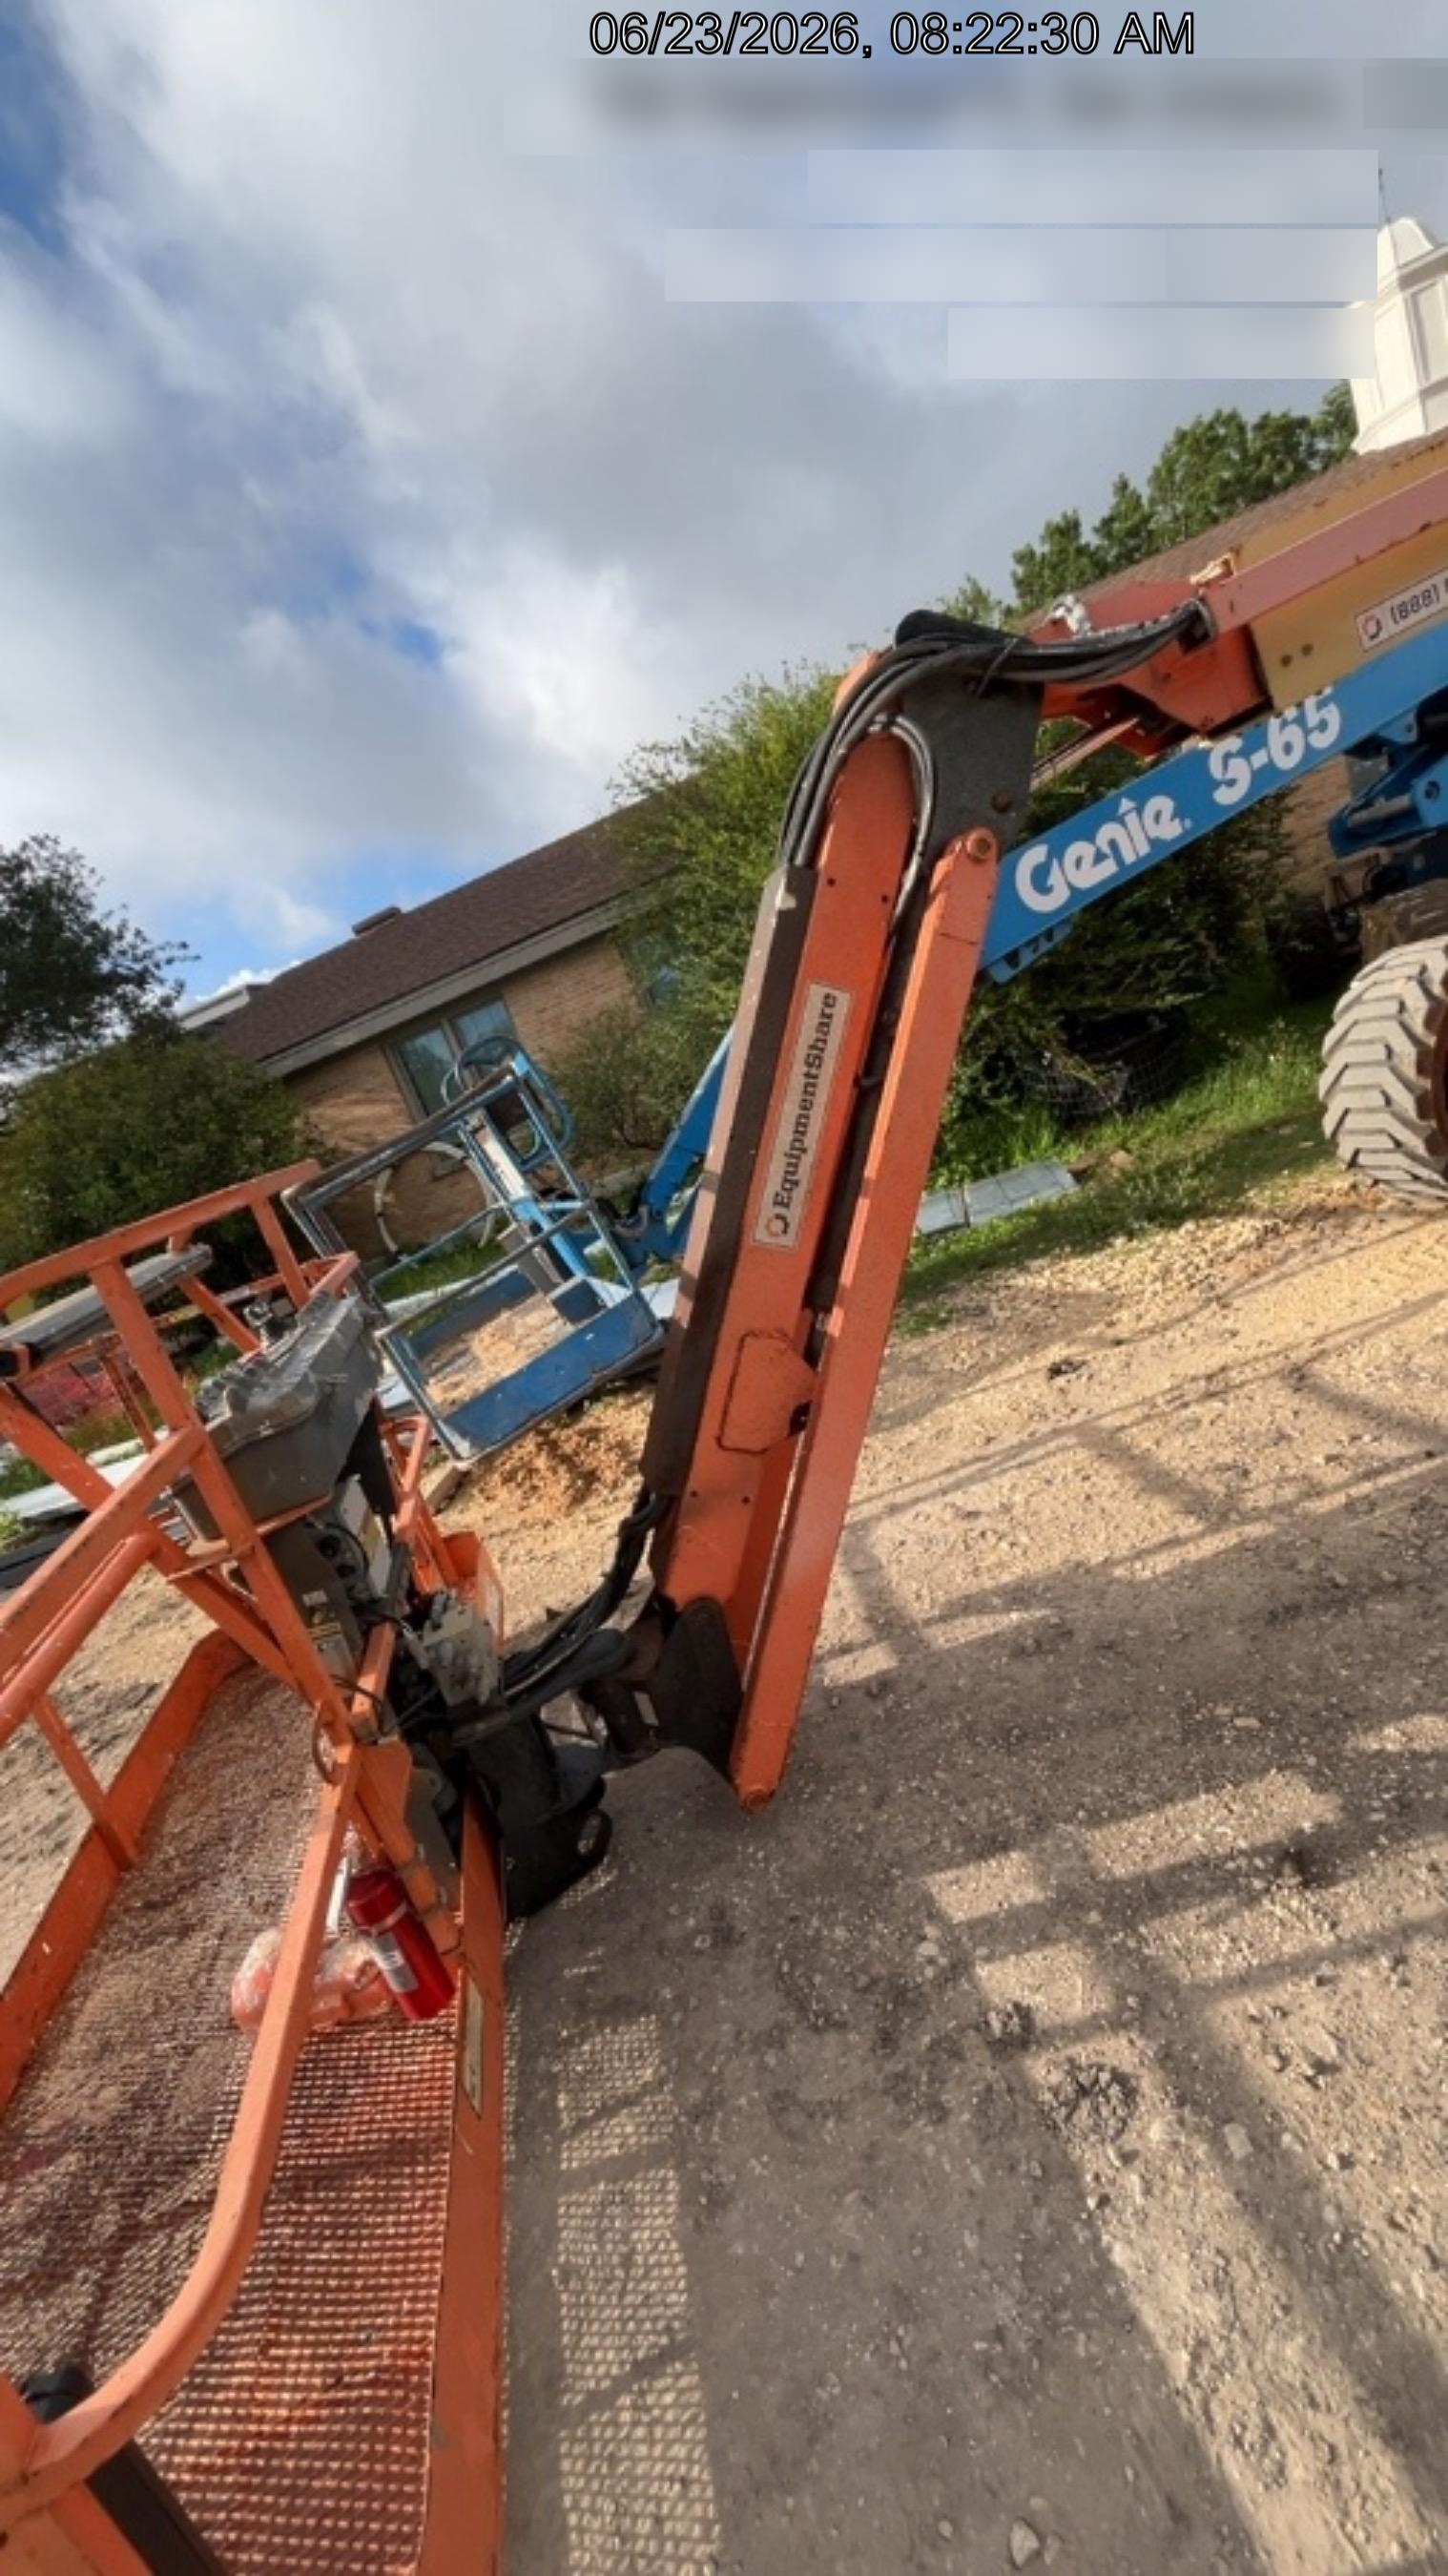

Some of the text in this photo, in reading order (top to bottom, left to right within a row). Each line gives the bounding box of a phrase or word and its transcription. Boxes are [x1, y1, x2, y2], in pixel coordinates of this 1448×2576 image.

[1390, 583, 1440, 625] (888)
[1015, 686, 1341, 914] Genie S-65
[773, 991, 838, 1210] EquipmentShare
